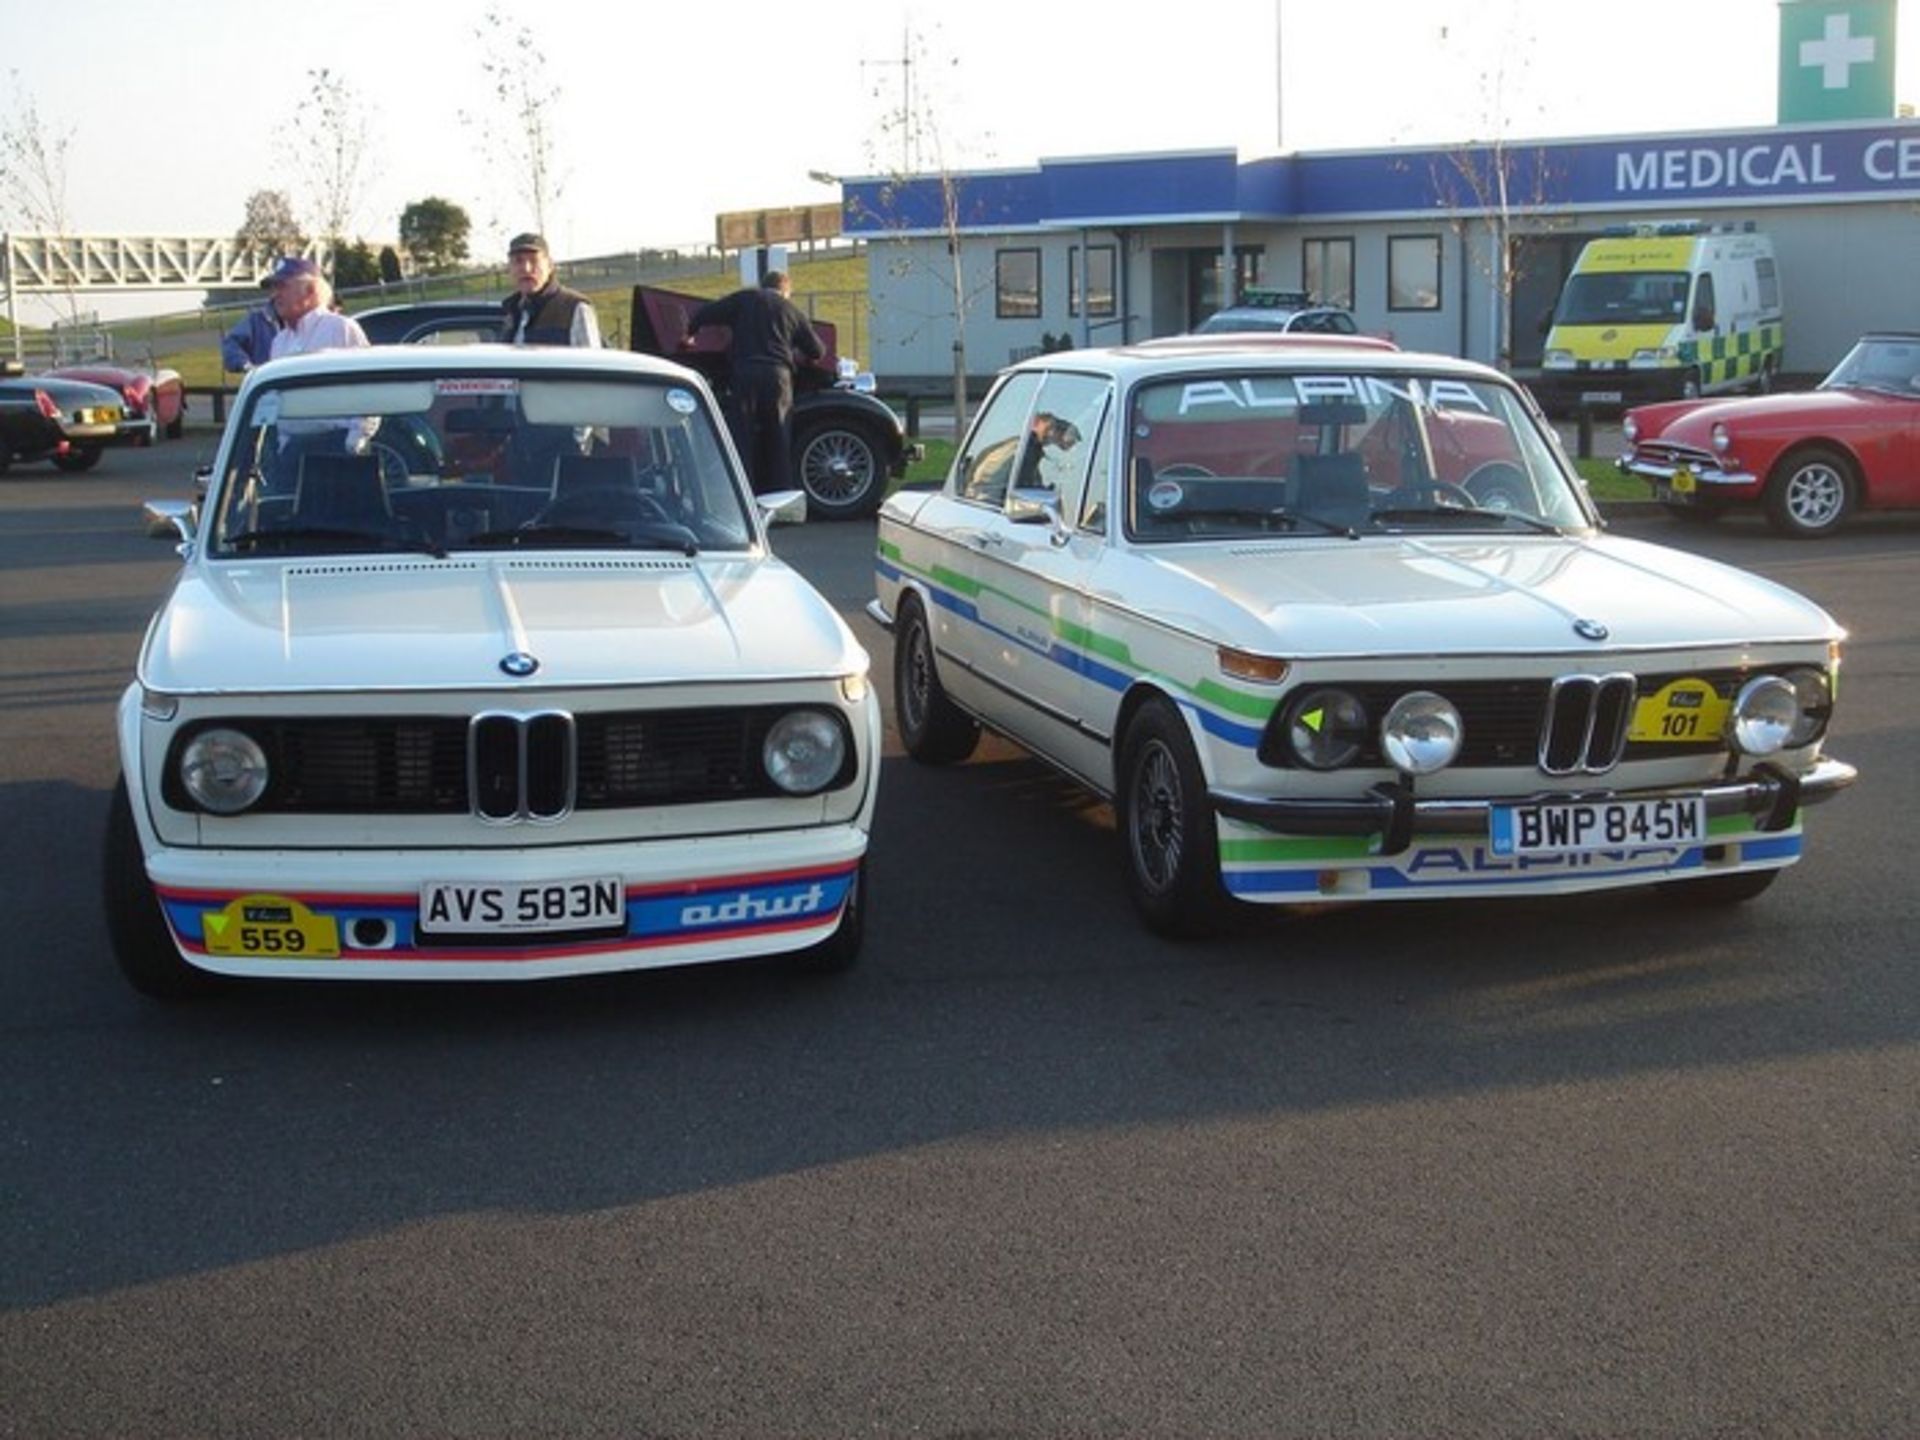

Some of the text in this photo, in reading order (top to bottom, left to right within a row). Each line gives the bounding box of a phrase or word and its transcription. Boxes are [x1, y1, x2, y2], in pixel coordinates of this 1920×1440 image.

[1615, 143, 1836, 191] MEDICAL
[1178, 376, 1489, 415] ALPINA
[1661, 713, 1698, 736] 101
[1519, 801, 1697, 848] BWP 845M
[429, 881, 617, 922] AVS 583N
[241, 928, 305, 953] 559
